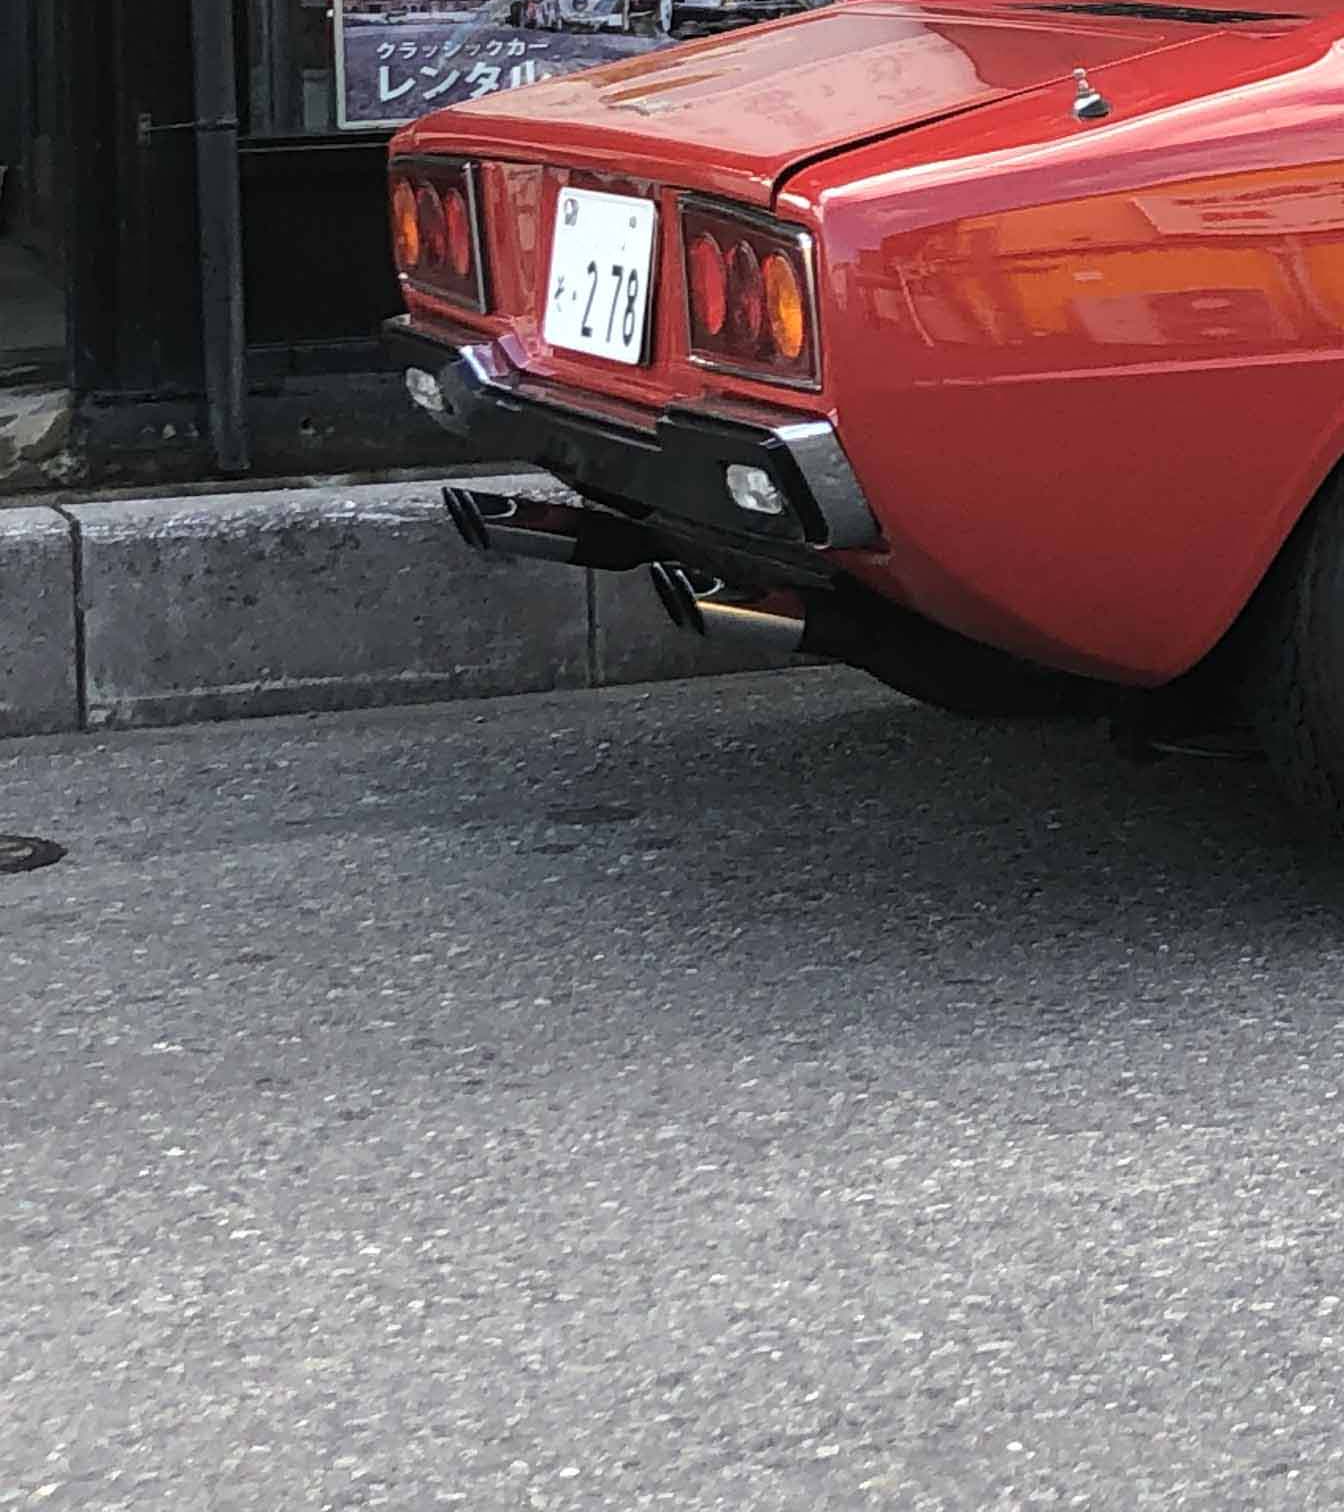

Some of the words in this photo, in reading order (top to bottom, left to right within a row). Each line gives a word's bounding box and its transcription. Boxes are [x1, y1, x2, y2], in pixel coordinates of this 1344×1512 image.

[376, 38, 549, 60] クラッシックカー
